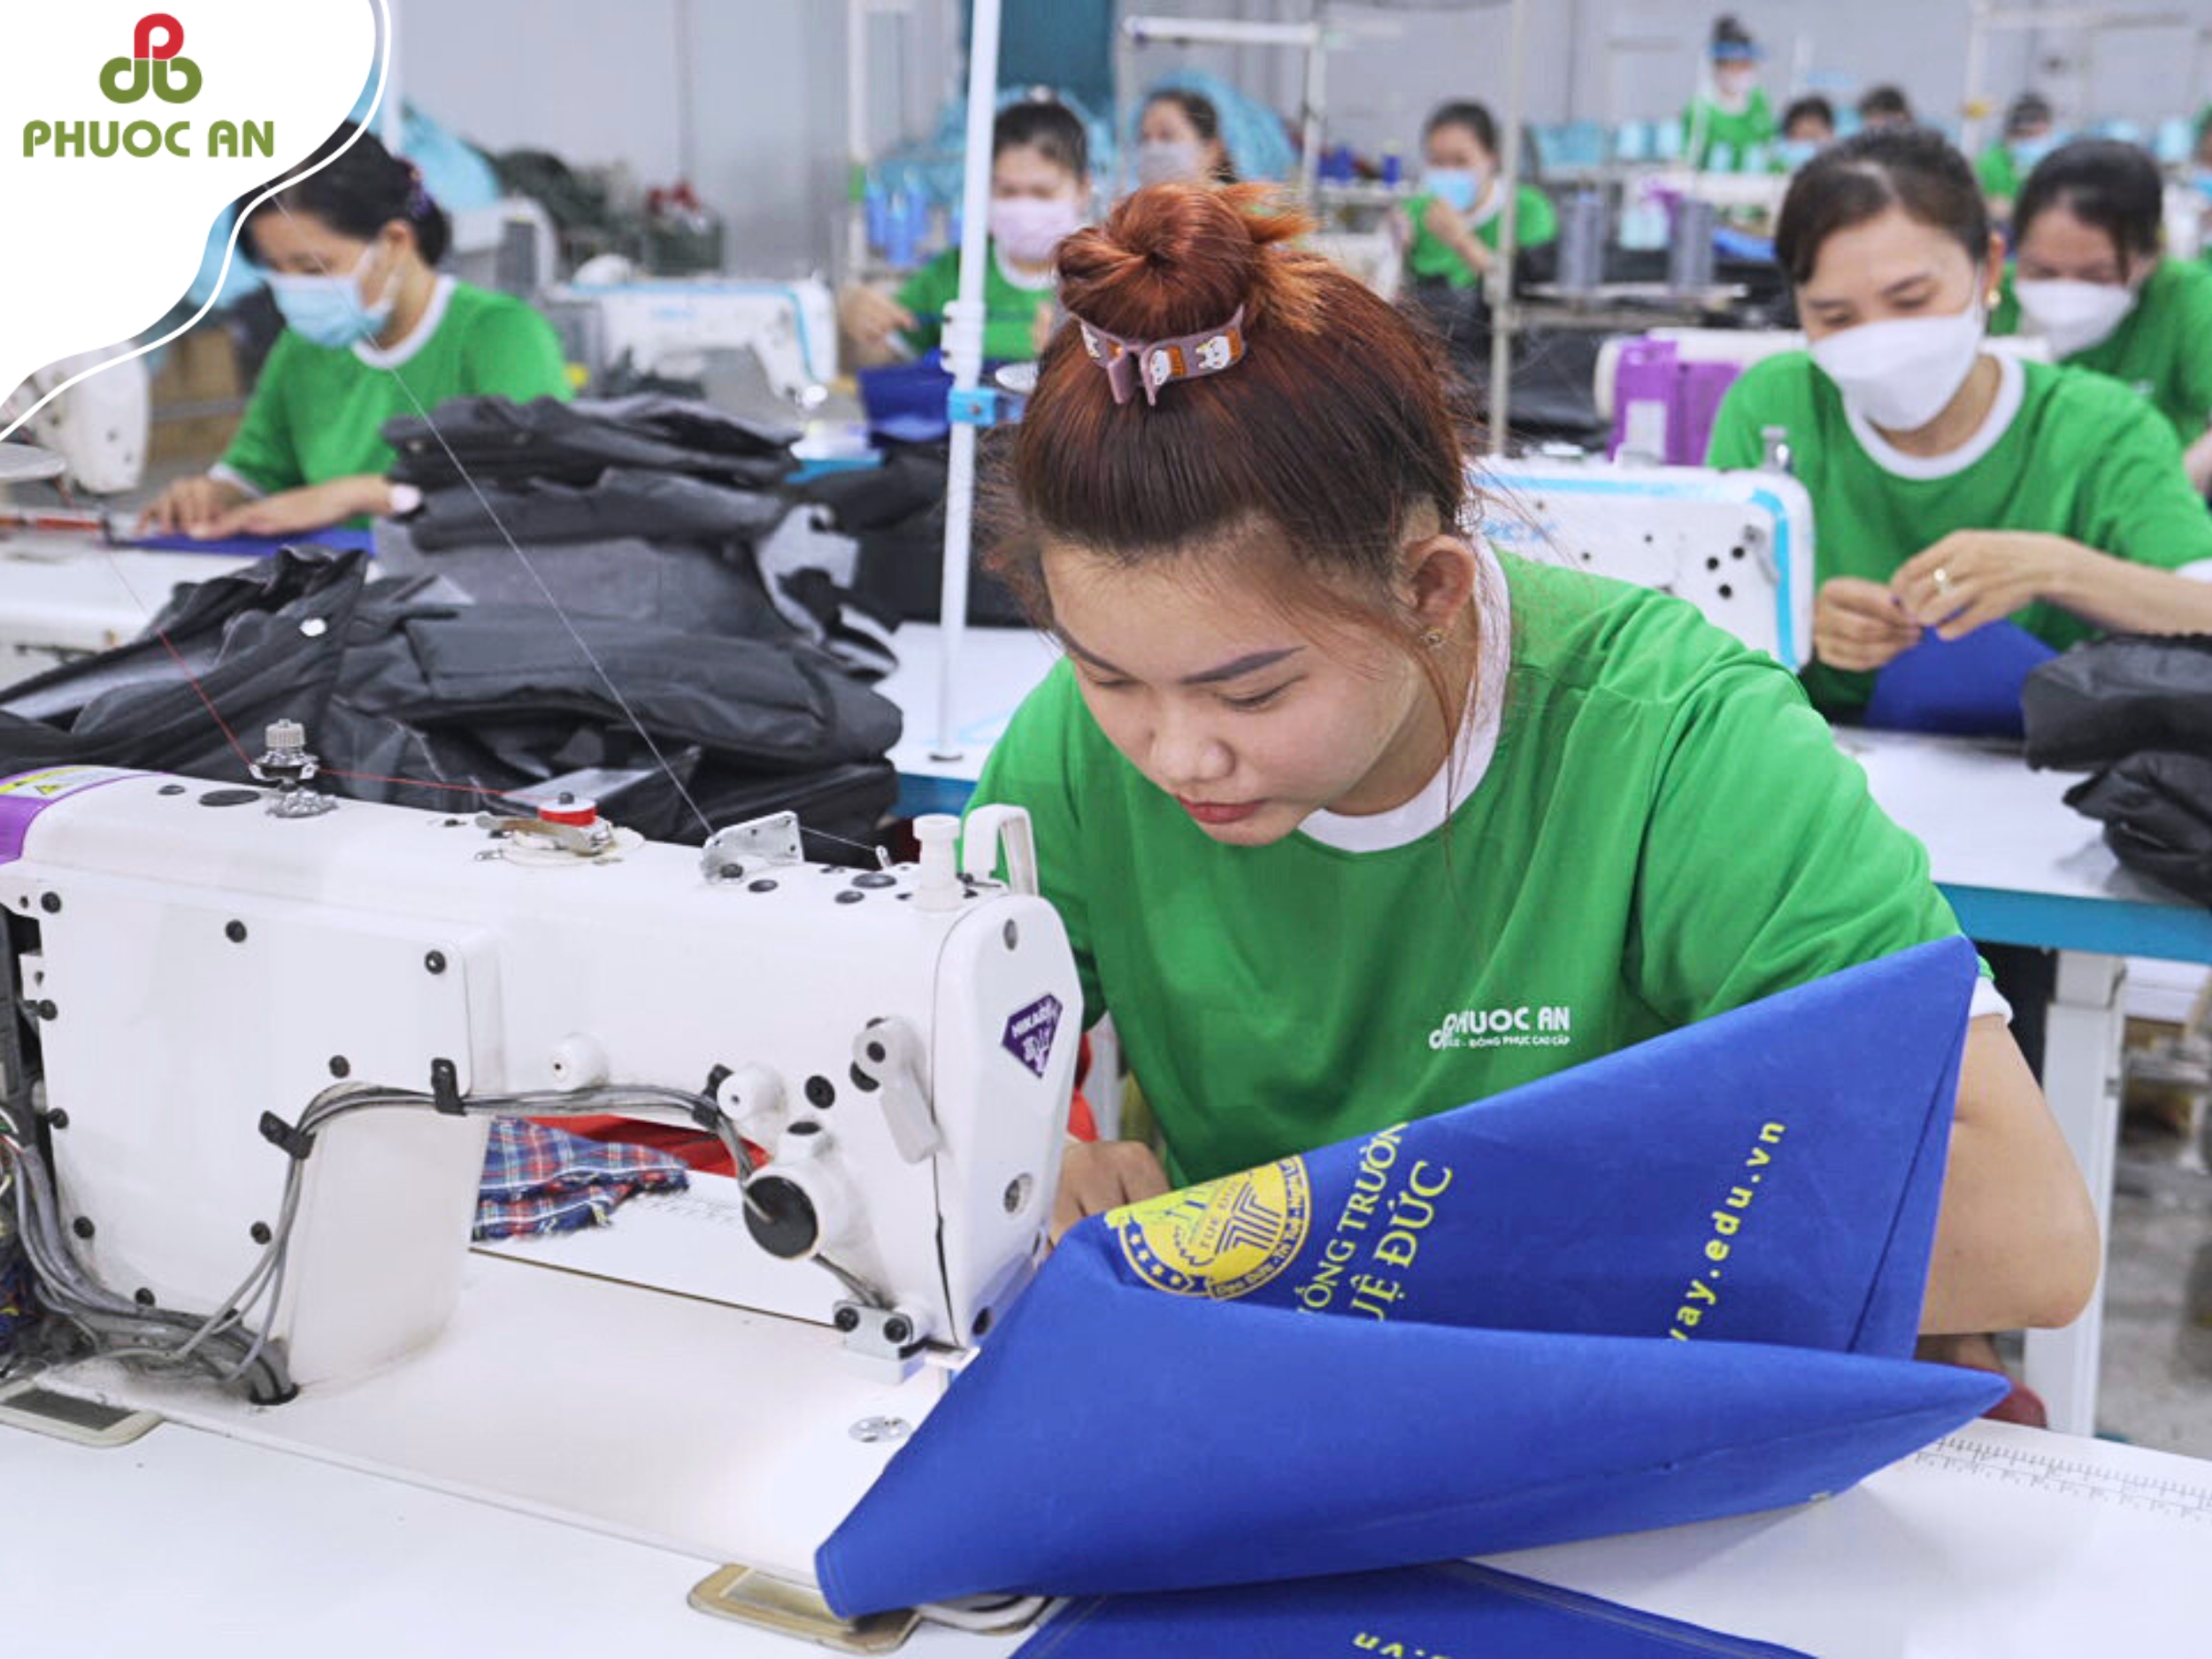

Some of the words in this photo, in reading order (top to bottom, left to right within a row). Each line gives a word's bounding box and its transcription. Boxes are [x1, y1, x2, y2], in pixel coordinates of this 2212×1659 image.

[1537, 1005, 1571, 1032] AN
[1374, 1160, 1453, 1269] ĐỨC
[1294, 1239, 1356, 1314] ỐNG
